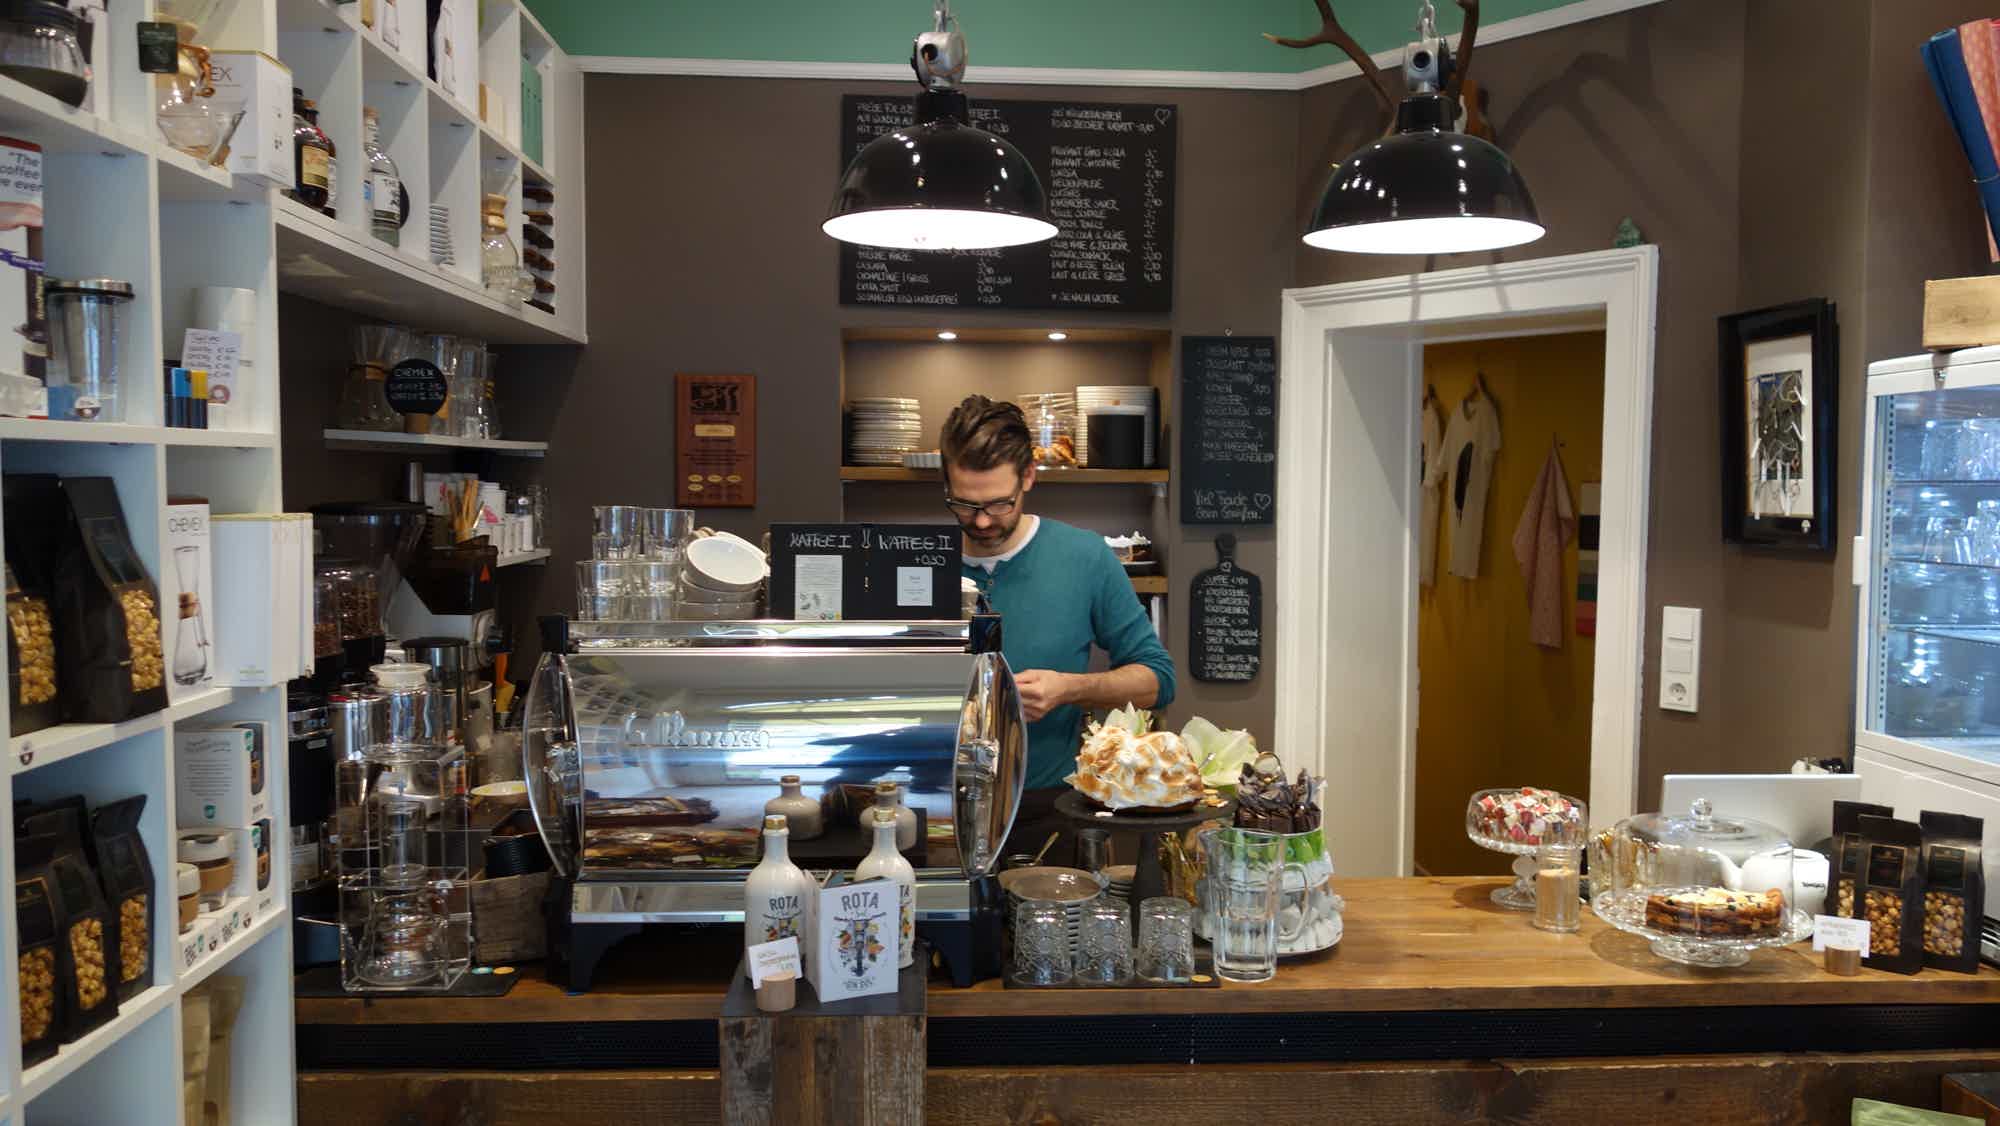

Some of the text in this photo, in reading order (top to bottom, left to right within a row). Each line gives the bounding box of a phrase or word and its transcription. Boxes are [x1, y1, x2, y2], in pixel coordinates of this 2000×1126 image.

[0, 165, 40, 180] coffee
[879, 535, 934, 551] KAFFEE
[655, 710, 769, 749] Marzocco
[900, 885, 911, 897] TA
[769, 896, 799, 911] ROTA
[841, 892, 880, 911] ROTA
